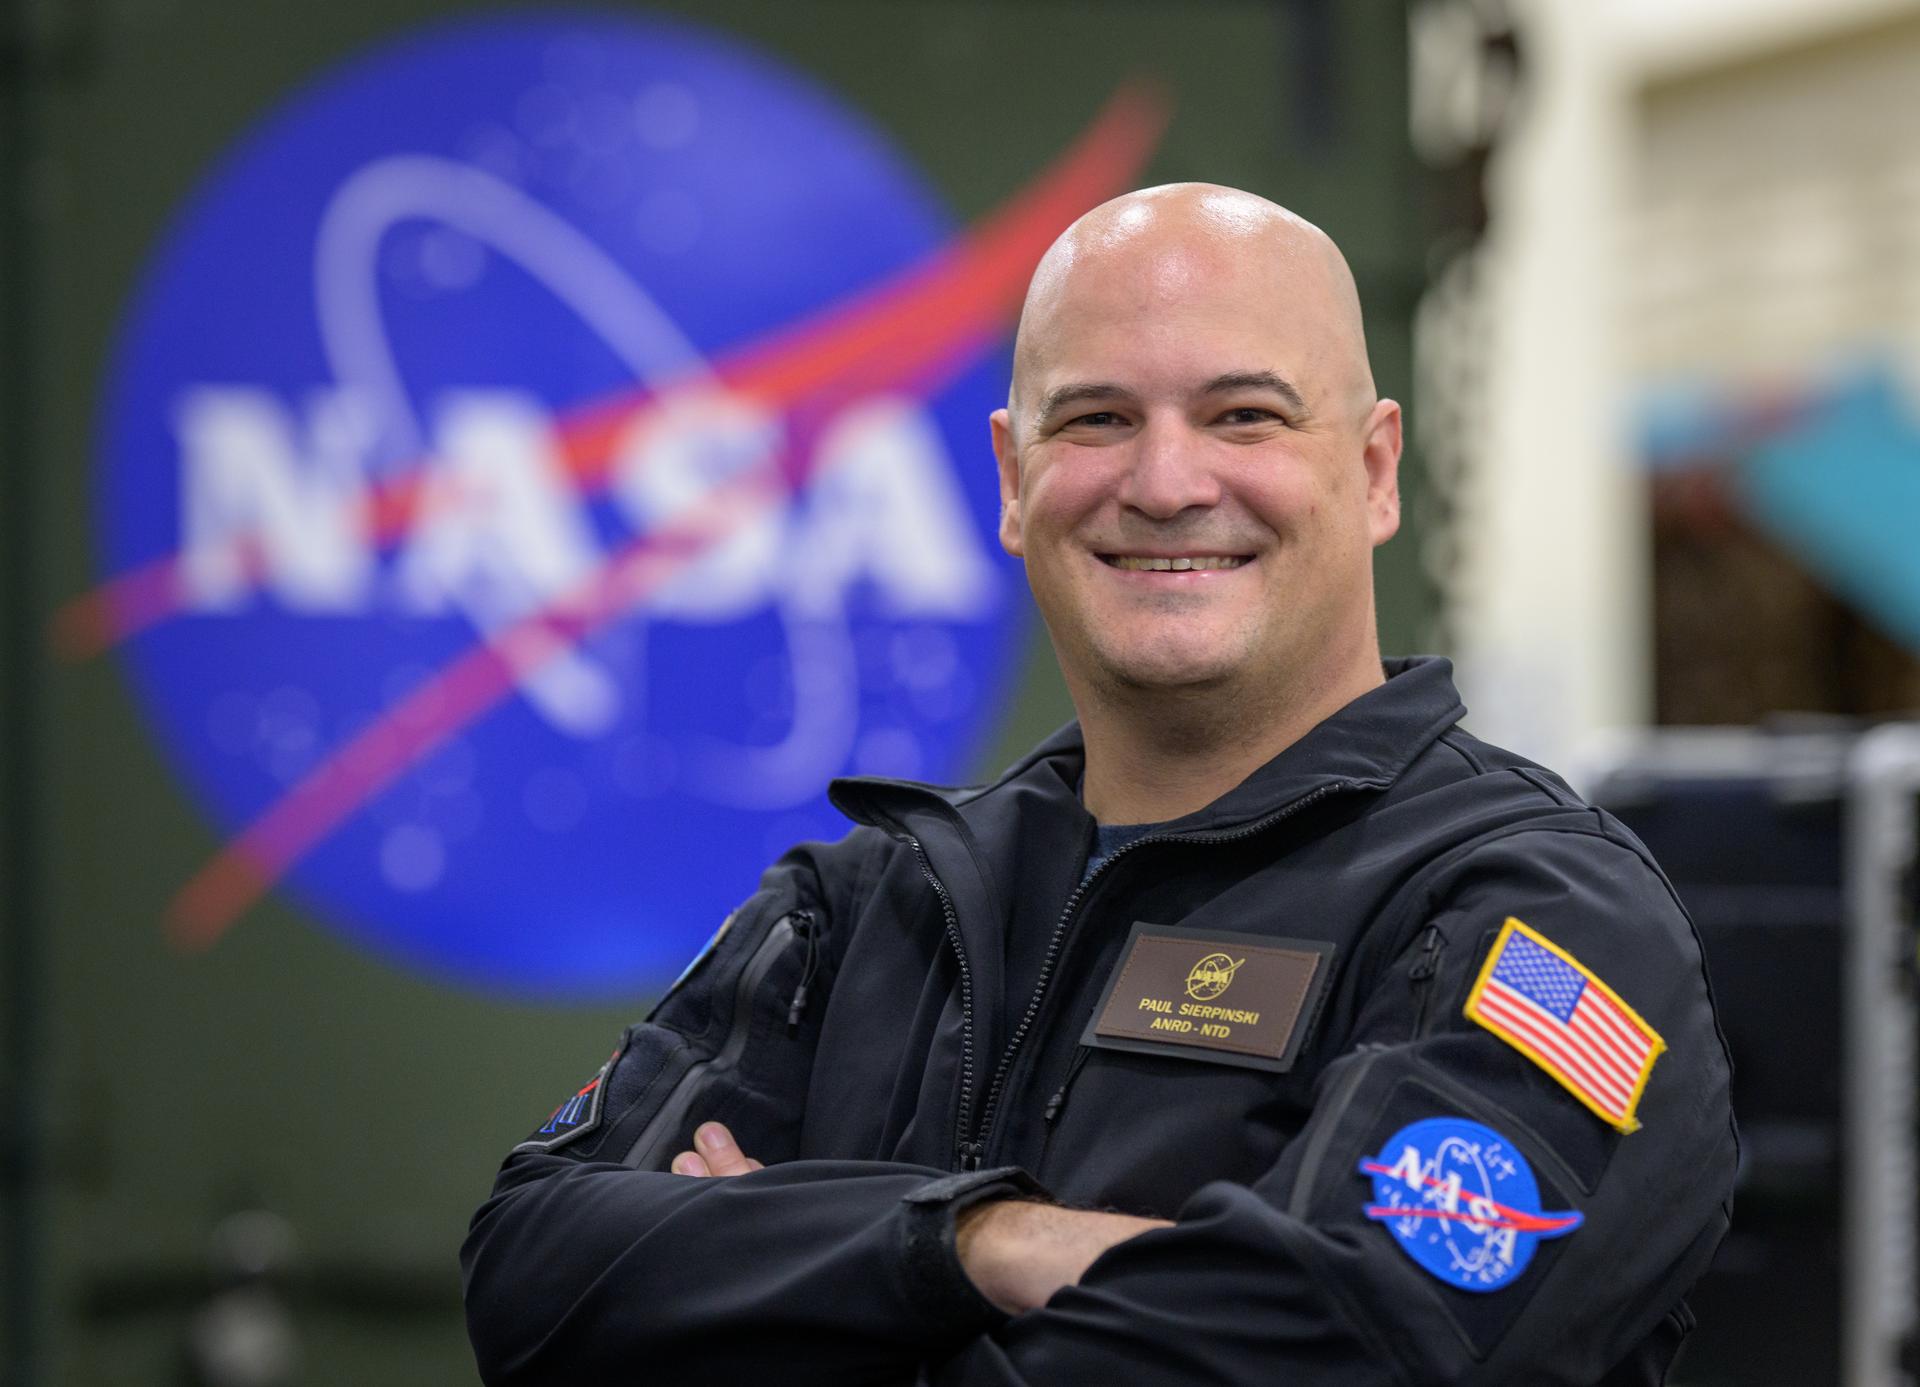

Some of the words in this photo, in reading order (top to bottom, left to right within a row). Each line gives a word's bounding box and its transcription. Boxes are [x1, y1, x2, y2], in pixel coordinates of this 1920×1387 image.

[177, 386, 994, 617] NASA
[1138, 997, 1173, 1014] PAUL
[1178, 1002, 1260, 1025] SIERPINSKI
[1388, 1145, 1518, 1266] NASA
